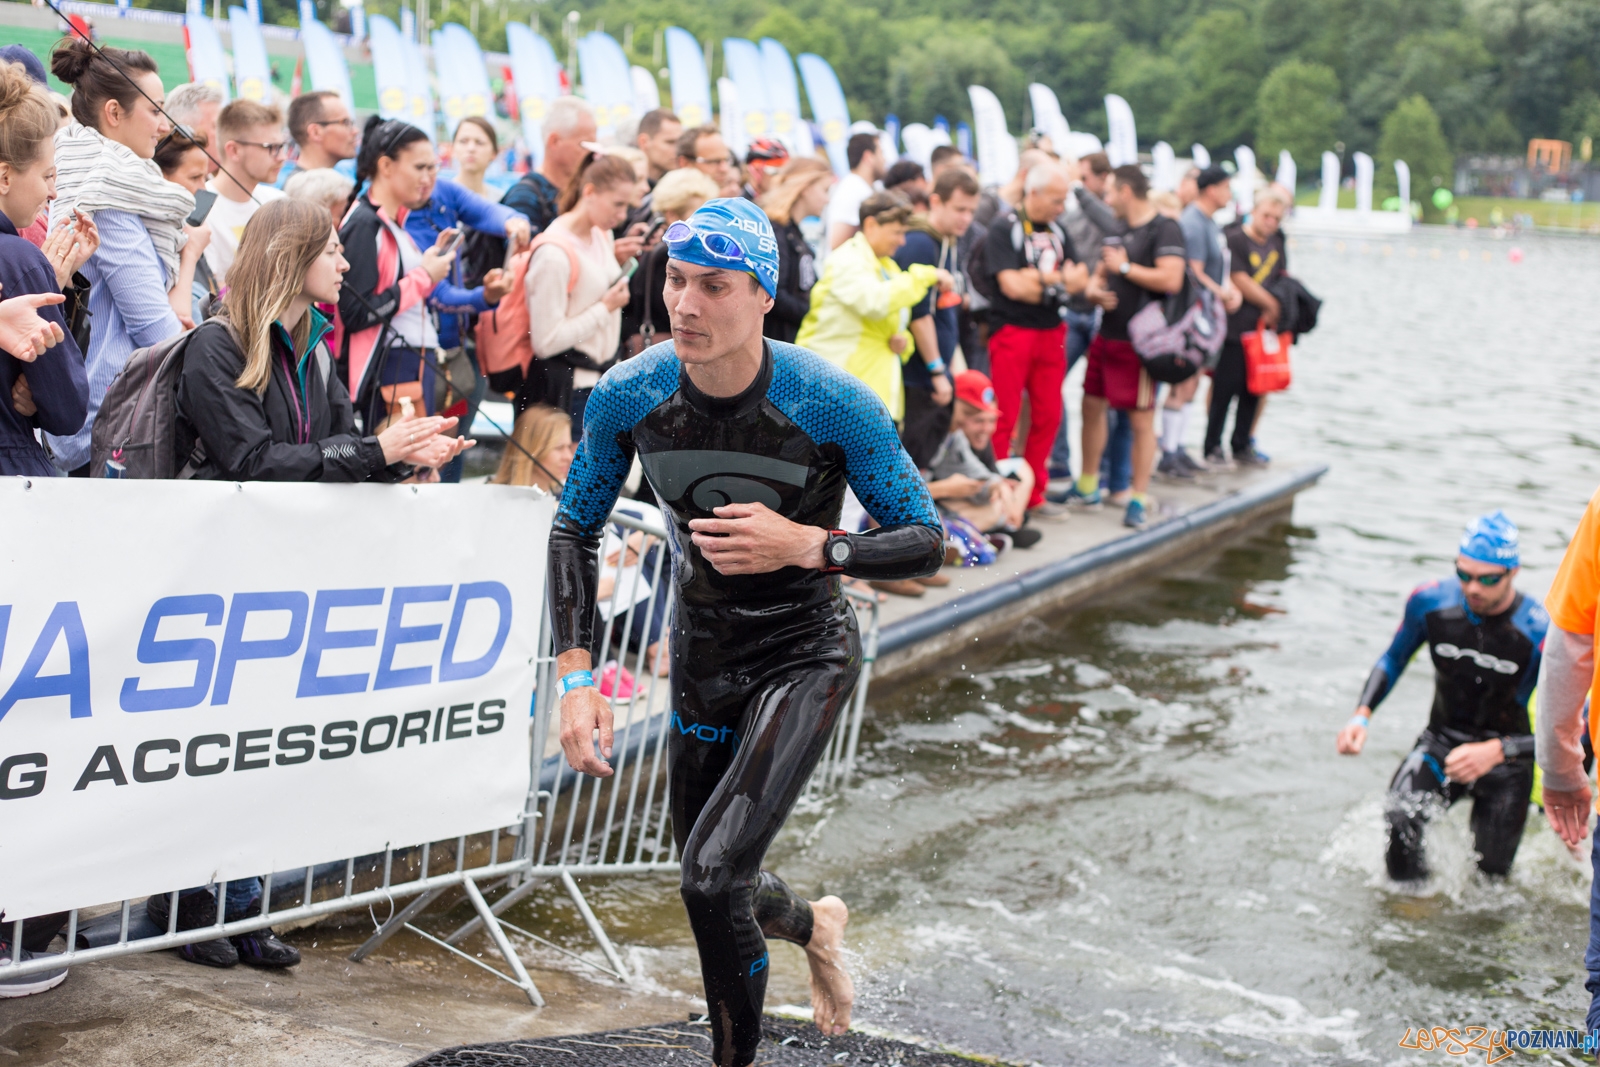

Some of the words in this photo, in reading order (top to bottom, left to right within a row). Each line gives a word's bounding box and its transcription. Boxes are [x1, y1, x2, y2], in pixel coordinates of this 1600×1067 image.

[0, 601, 93, 728] A
[119, 580, 513, 713] SPEED
[1435, 643, 1519, 675] orca
[72, 698, 507, 792] ACCESSORIES
[669, 710, 733, 743] ivot
